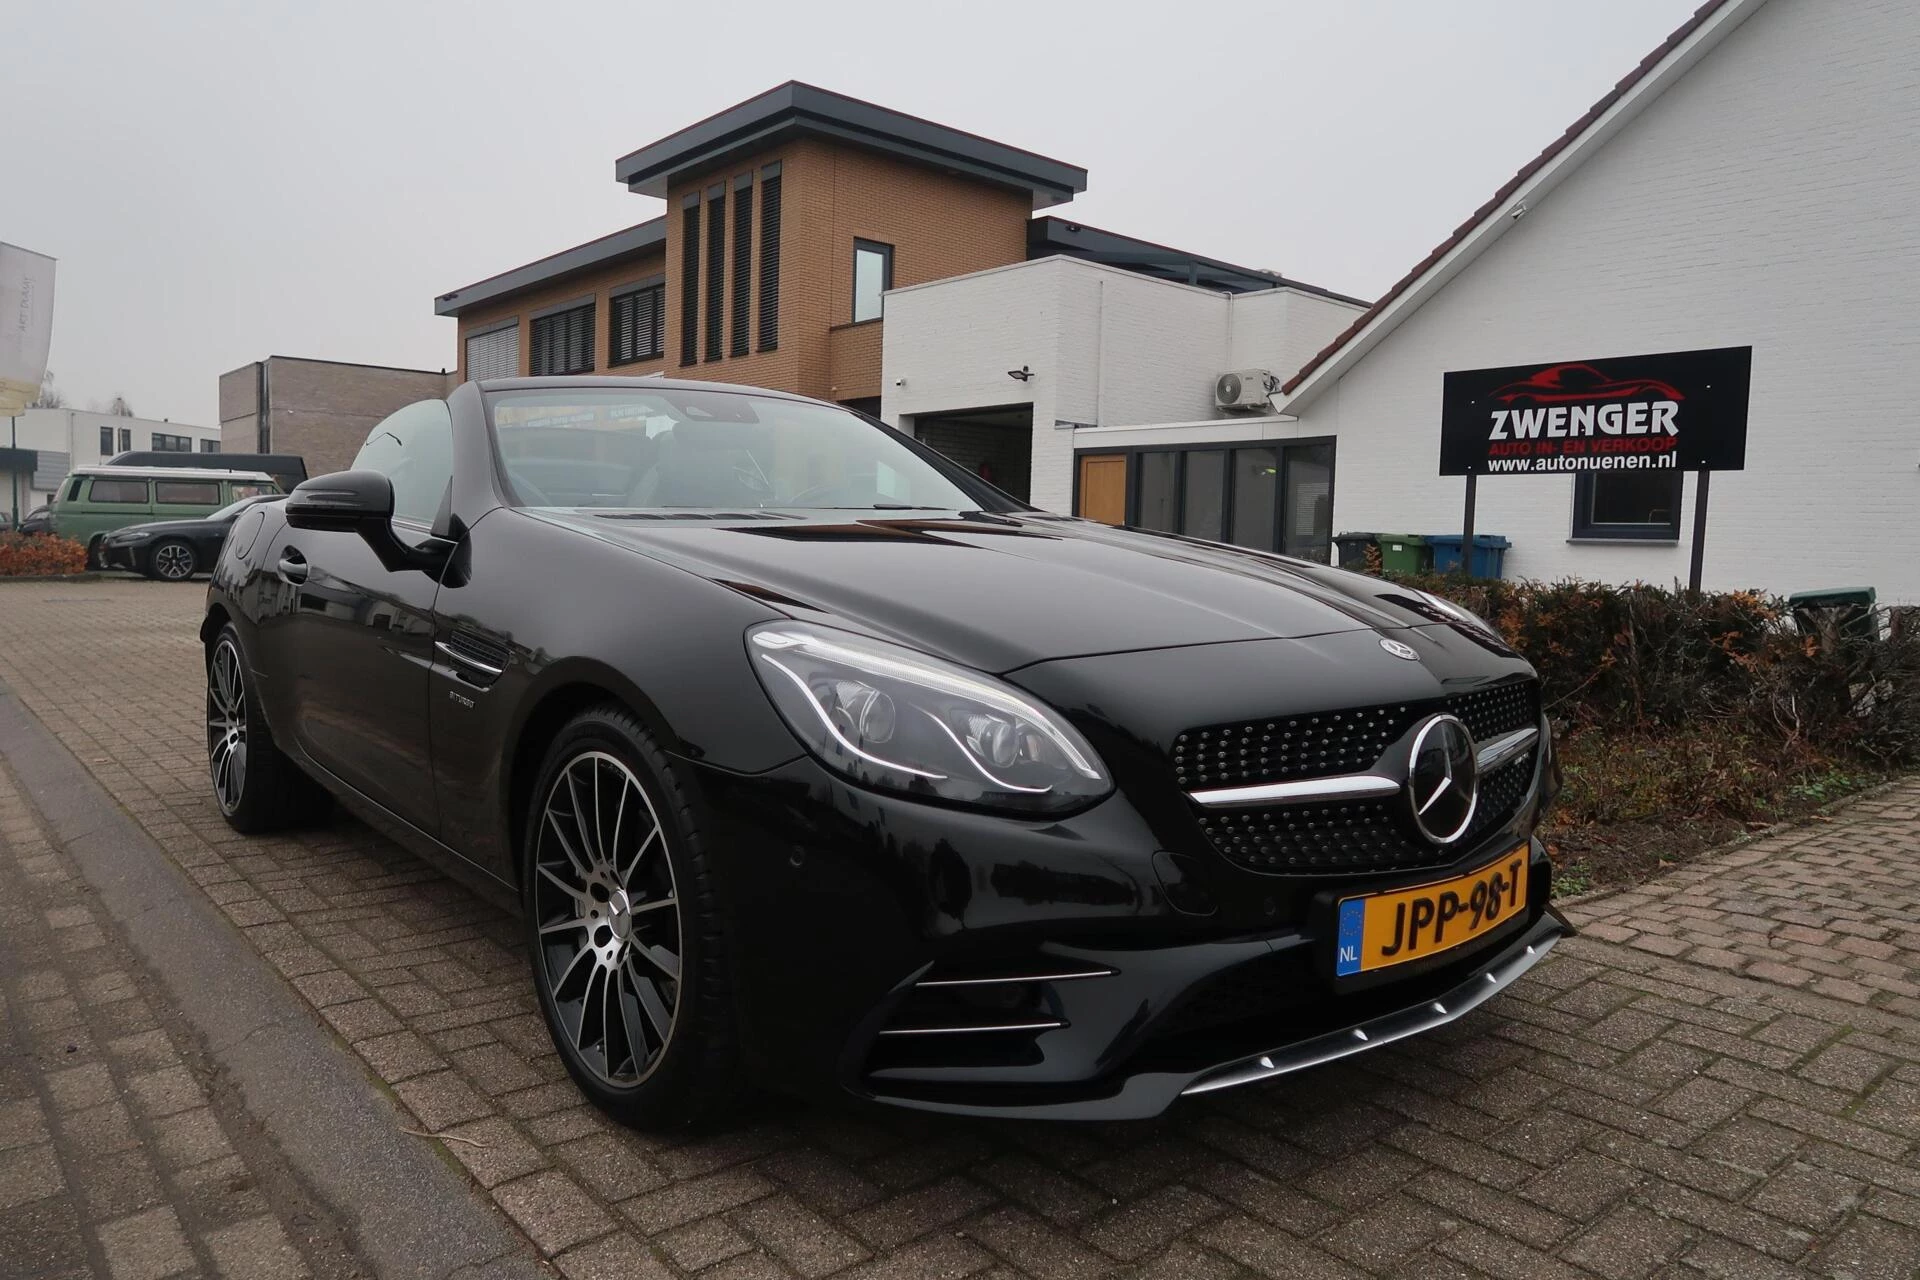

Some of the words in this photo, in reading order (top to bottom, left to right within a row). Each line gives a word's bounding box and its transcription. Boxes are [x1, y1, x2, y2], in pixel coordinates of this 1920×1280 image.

[1489, 401, 1679, 440] ZWENGER
[1488, 442, 1532, 456] AUTO
[1536, 441, 1558, 454] IN-
[1563, 440, 1585, 454] EN
[1591, 436, 1677, 453] VERKOOP
[1488, 451, 1677, 472] www.autonuenen.nl
[1381, 858, 1522, 957] JPP-98-T
[1340, 946, 1358, 963] NL
